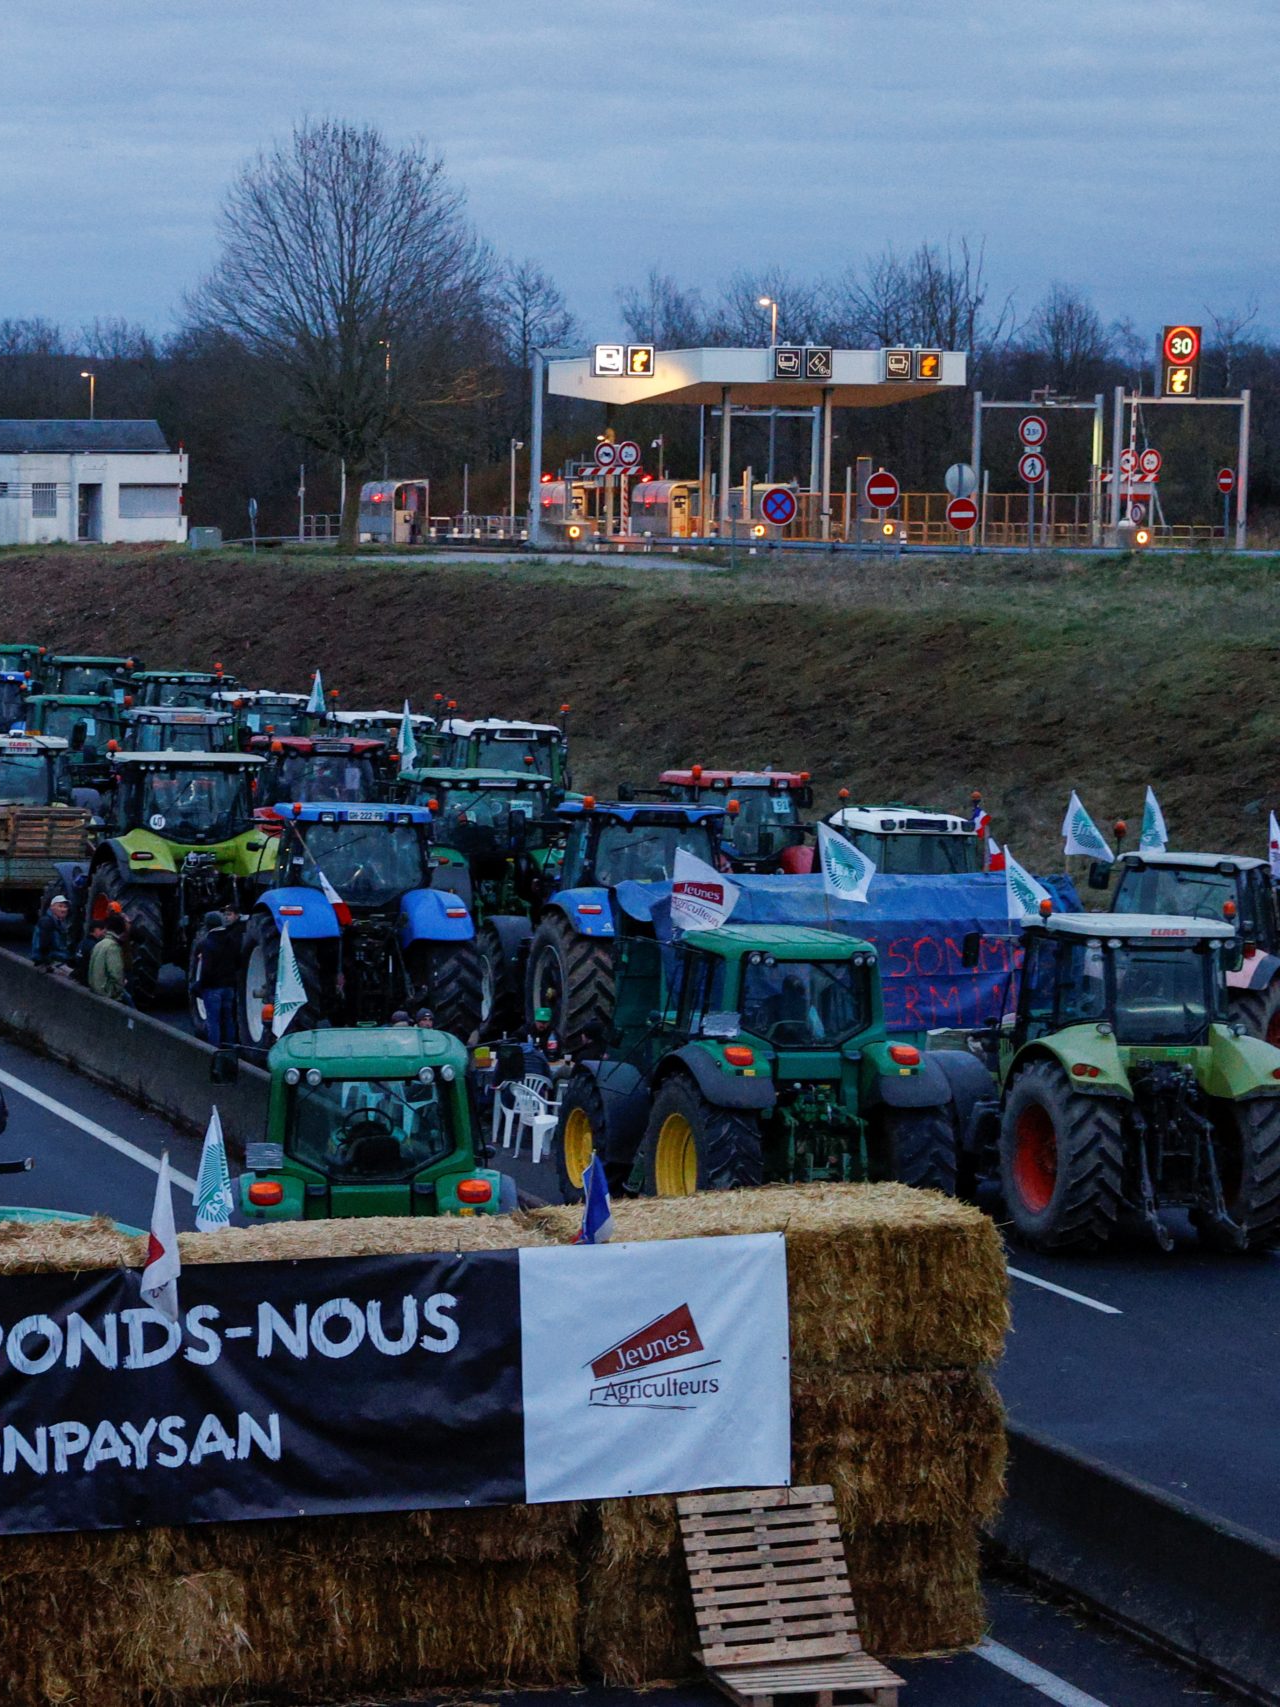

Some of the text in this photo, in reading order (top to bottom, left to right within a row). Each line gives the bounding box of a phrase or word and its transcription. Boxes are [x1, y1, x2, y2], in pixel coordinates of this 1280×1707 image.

[1171, 337, 1192, 355] 30
[682, 883, 720, 900] Jeunes
[1151, 928, 1187, 936] CLAAS
[615, 1328, 691, 1371] Jeunes
[602, 1377, 720, 1405] Agriculteurs
